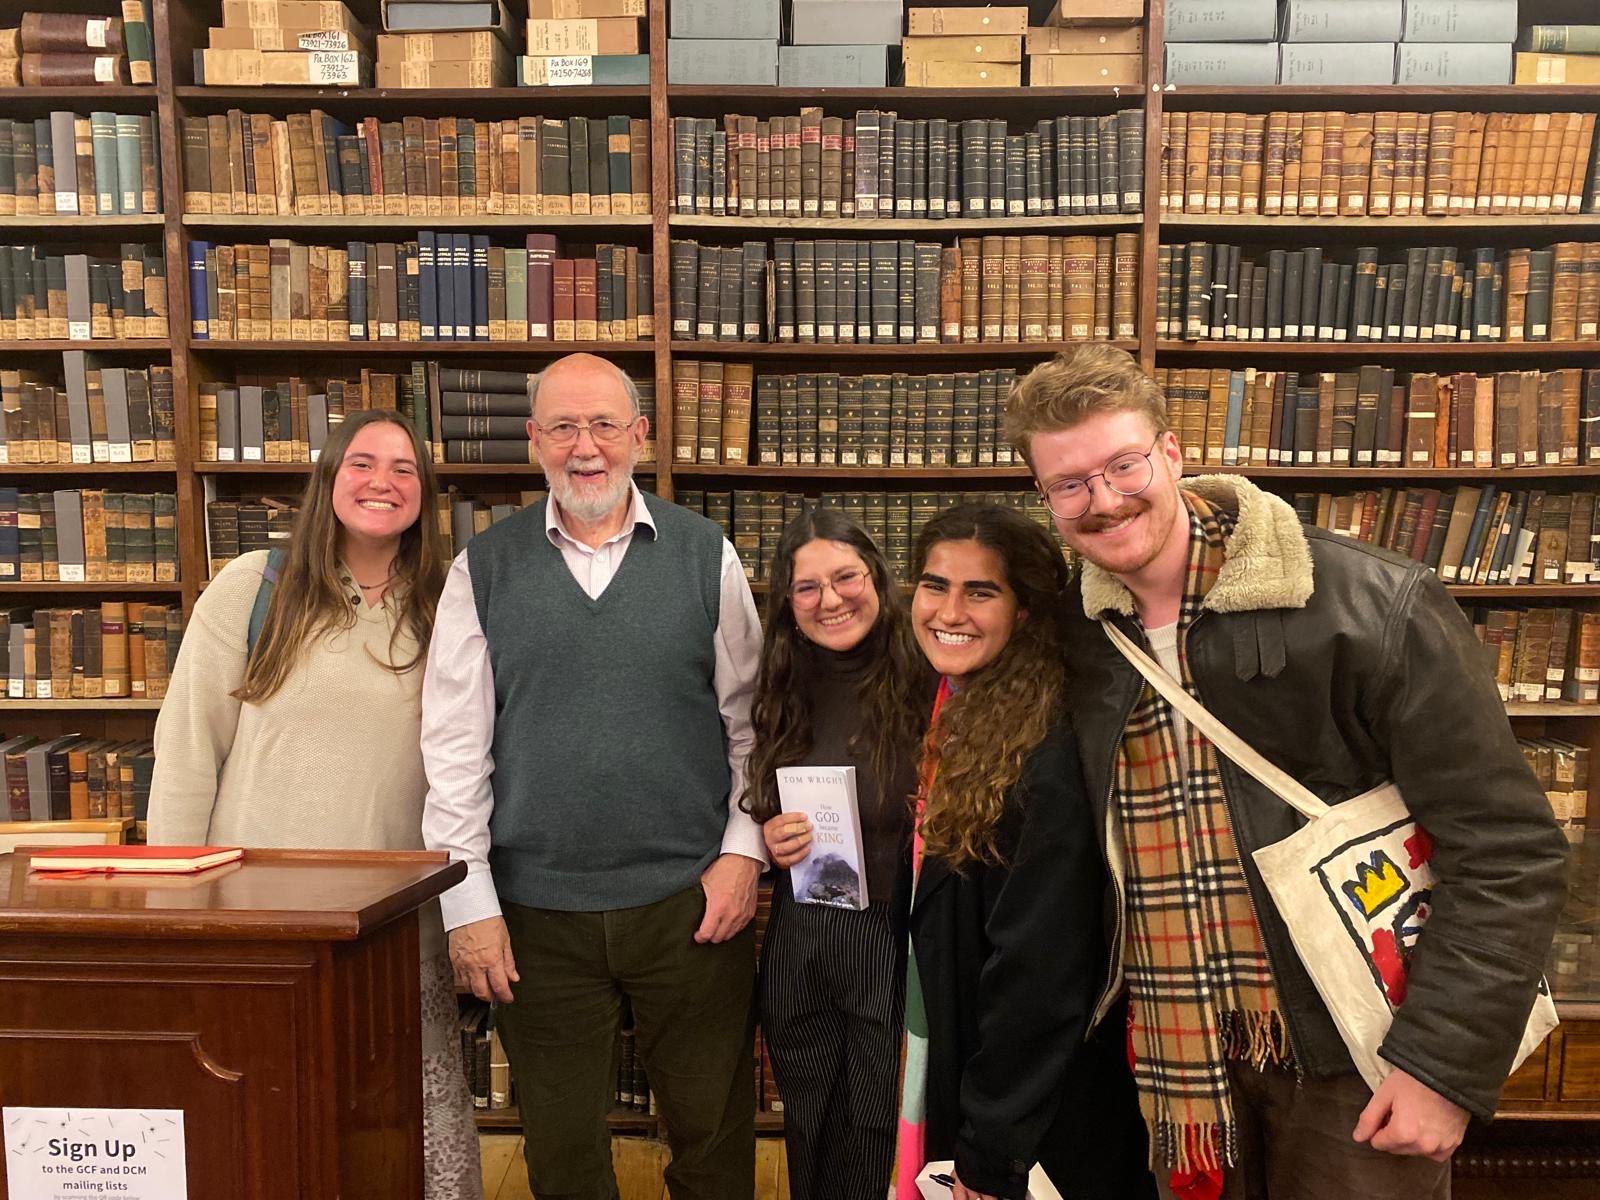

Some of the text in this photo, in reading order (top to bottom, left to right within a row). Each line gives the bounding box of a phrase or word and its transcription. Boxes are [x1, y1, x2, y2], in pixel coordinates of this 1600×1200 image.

[328, 31, 340, 40] 161
[340, 53, 355, 63] 162
[575, 57, 588, 67] 169
[320, 71, 347, 80] 73963
[784, 776, 843, 785] TOM WRIGHT
[815, 811, 840, 823] GOD
[816, 830, 844, 845] KING
[48, 1138, 136, 1162] Sign Up
[42, 1165, 147, 1175] to the GCF and DCM
[63, 1181, 128, 1192] mailing lists
